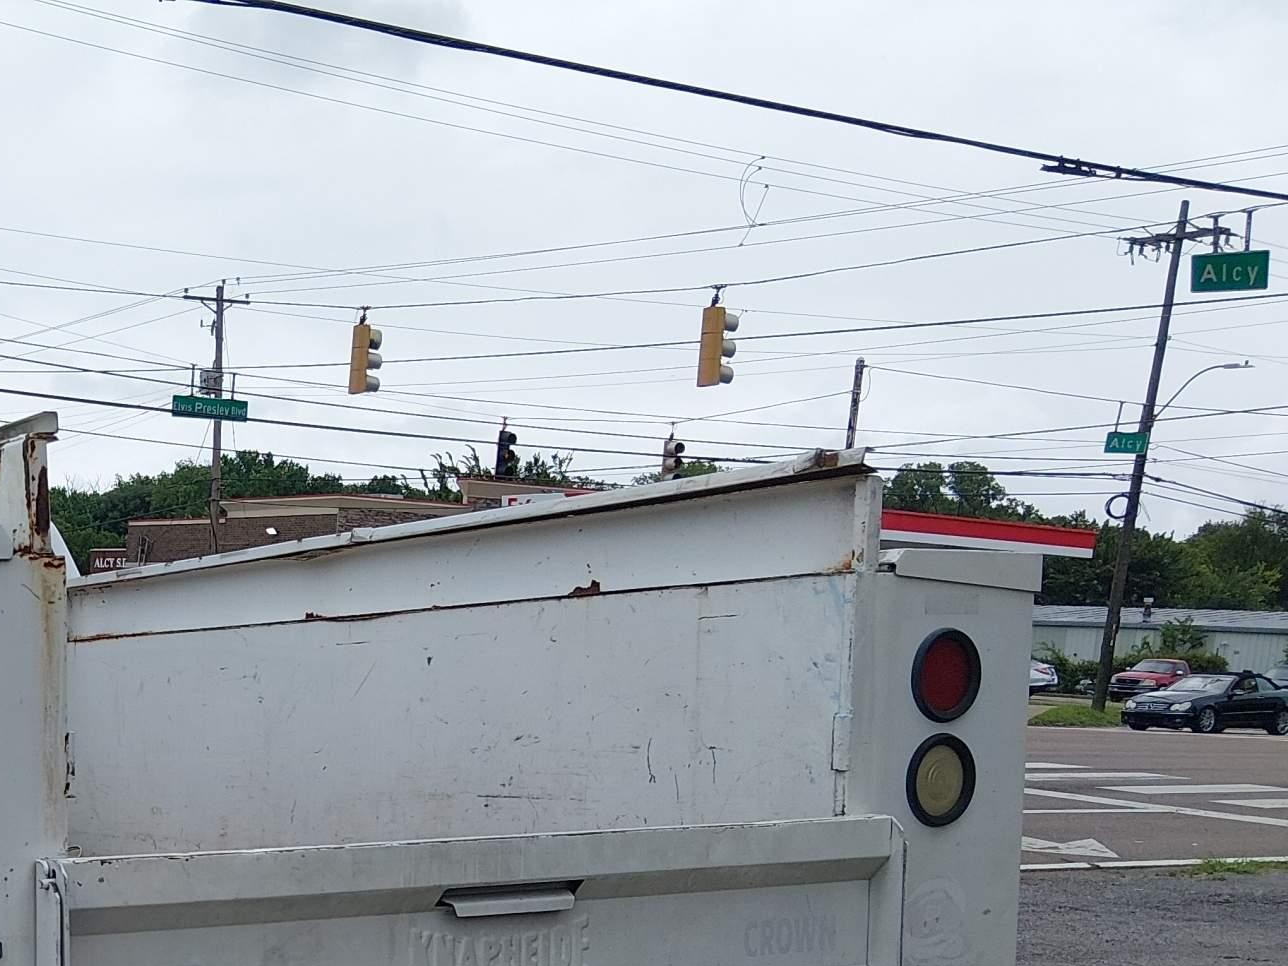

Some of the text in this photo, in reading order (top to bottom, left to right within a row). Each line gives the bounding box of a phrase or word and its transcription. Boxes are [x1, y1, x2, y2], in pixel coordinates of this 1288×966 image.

[1199, 263, 1259, 286] Alcy
[173, 400, 247, 417] Elvis Presley Blvd
[1109, 437, 1142, 452] Alcy
[94, 557, 115, 568] ALCY
